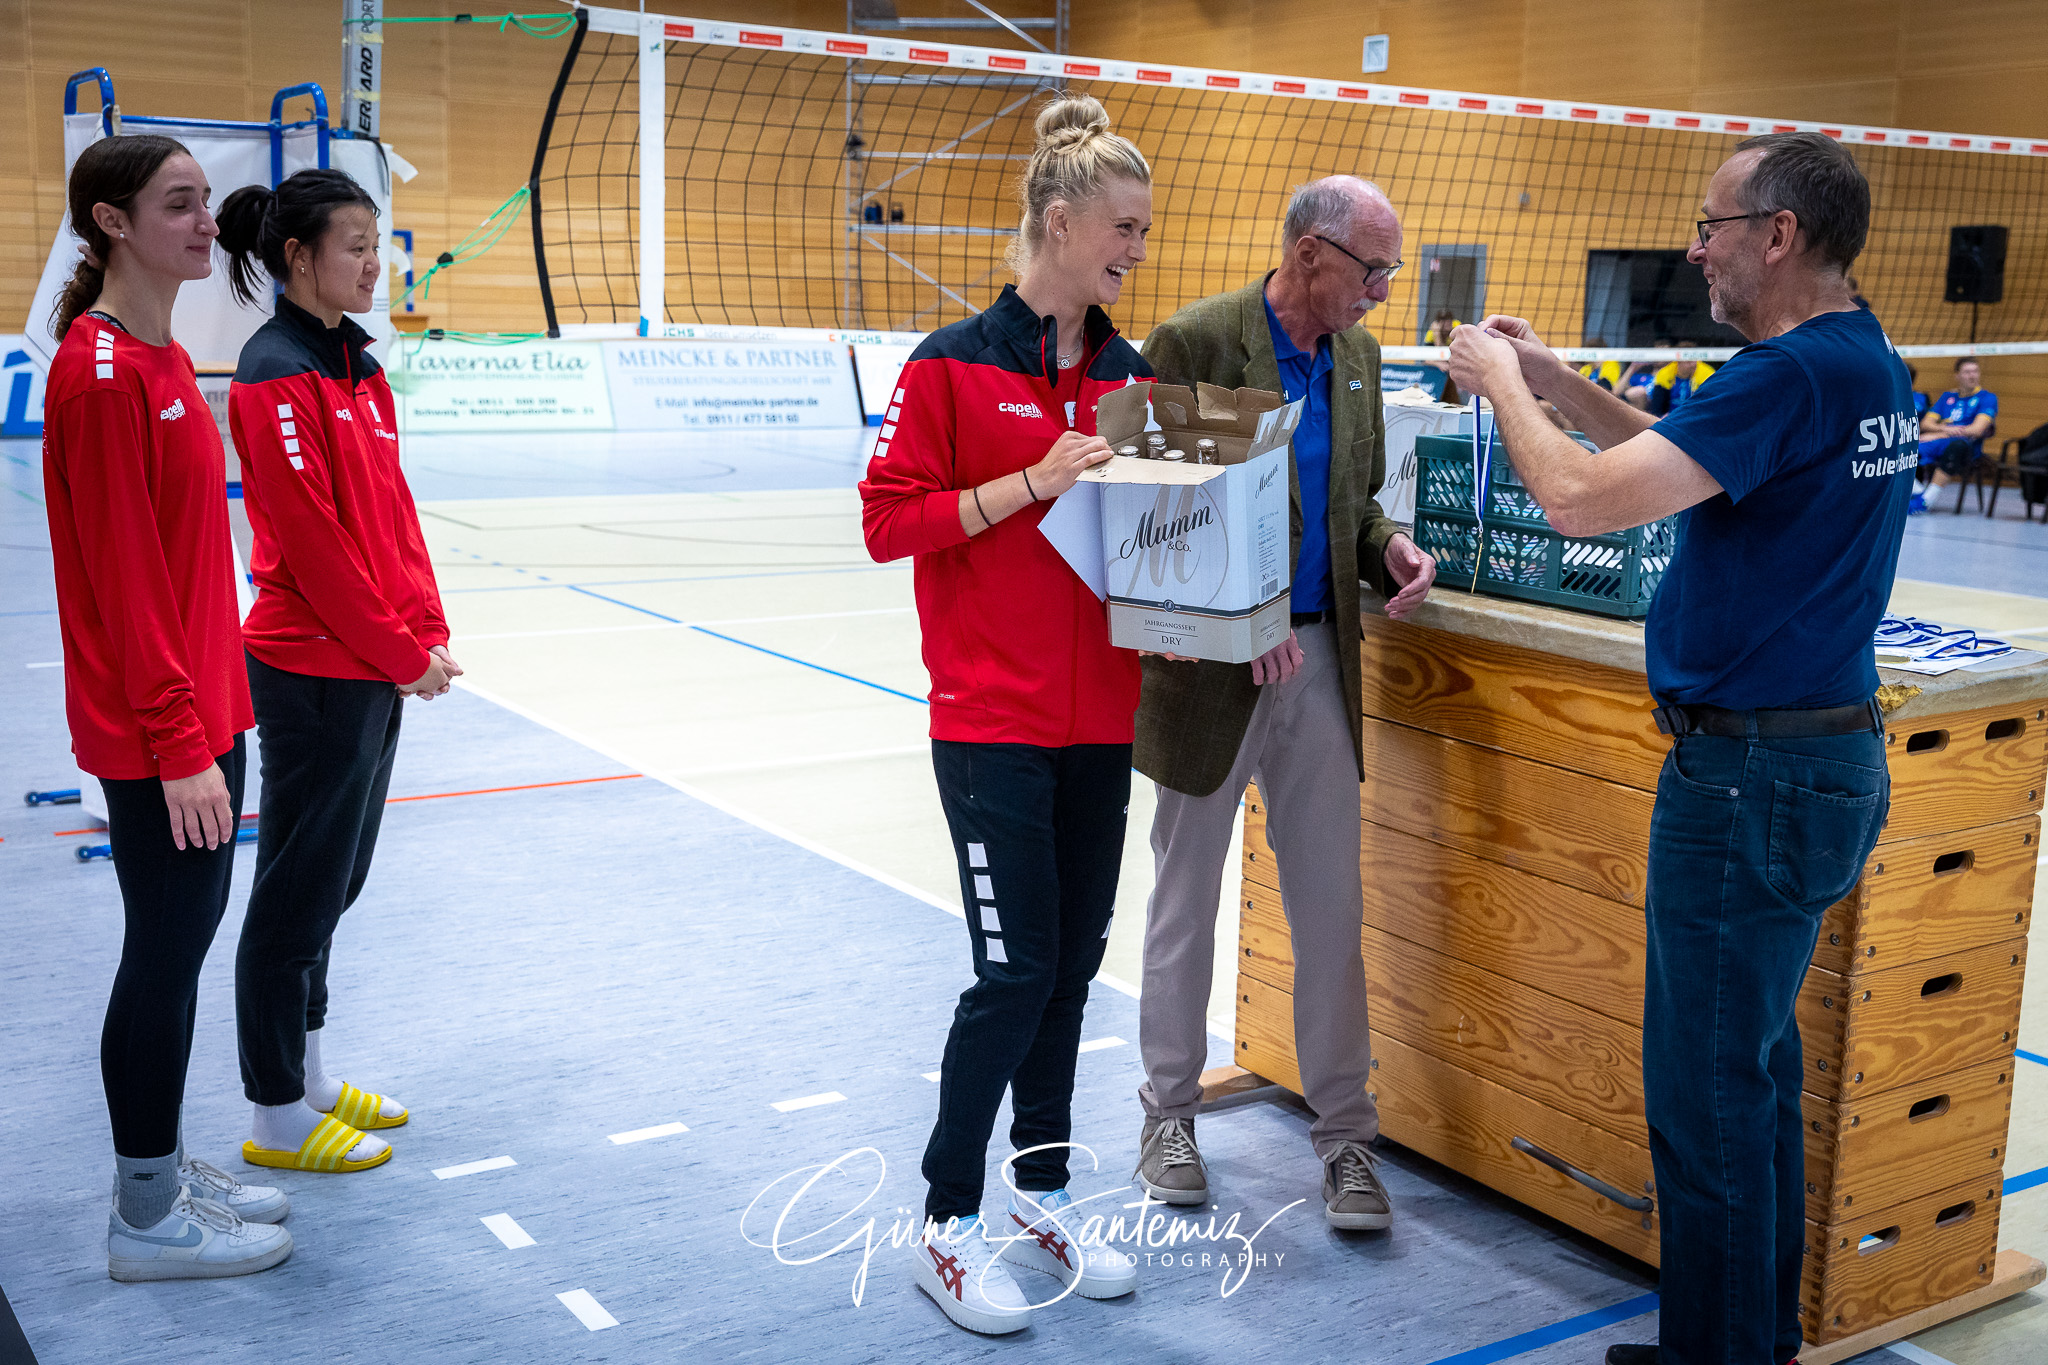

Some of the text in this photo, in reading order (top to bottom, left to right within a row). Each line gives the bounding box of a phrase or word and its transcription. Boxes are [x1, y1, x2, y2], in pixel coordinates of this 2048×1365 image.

[358, 47, 373, 132] ERARD
[841, 333, 882, 344] FUCHS
[404, 350, 590, 371] Taverna Elia
[618, 349, 837, 367] MEINCKE & PARTNER
[706, 414, 733, 425] 0911
[1858, 413, 1896, 453] SV
[1255, 463, 1279, 499] Mumm
[1119, 505, 1214, 559] Mumm
[1144, 619, 1197, 632] JAHRGANGSSEKT
[1161, 635, 1182, 646] DRY
